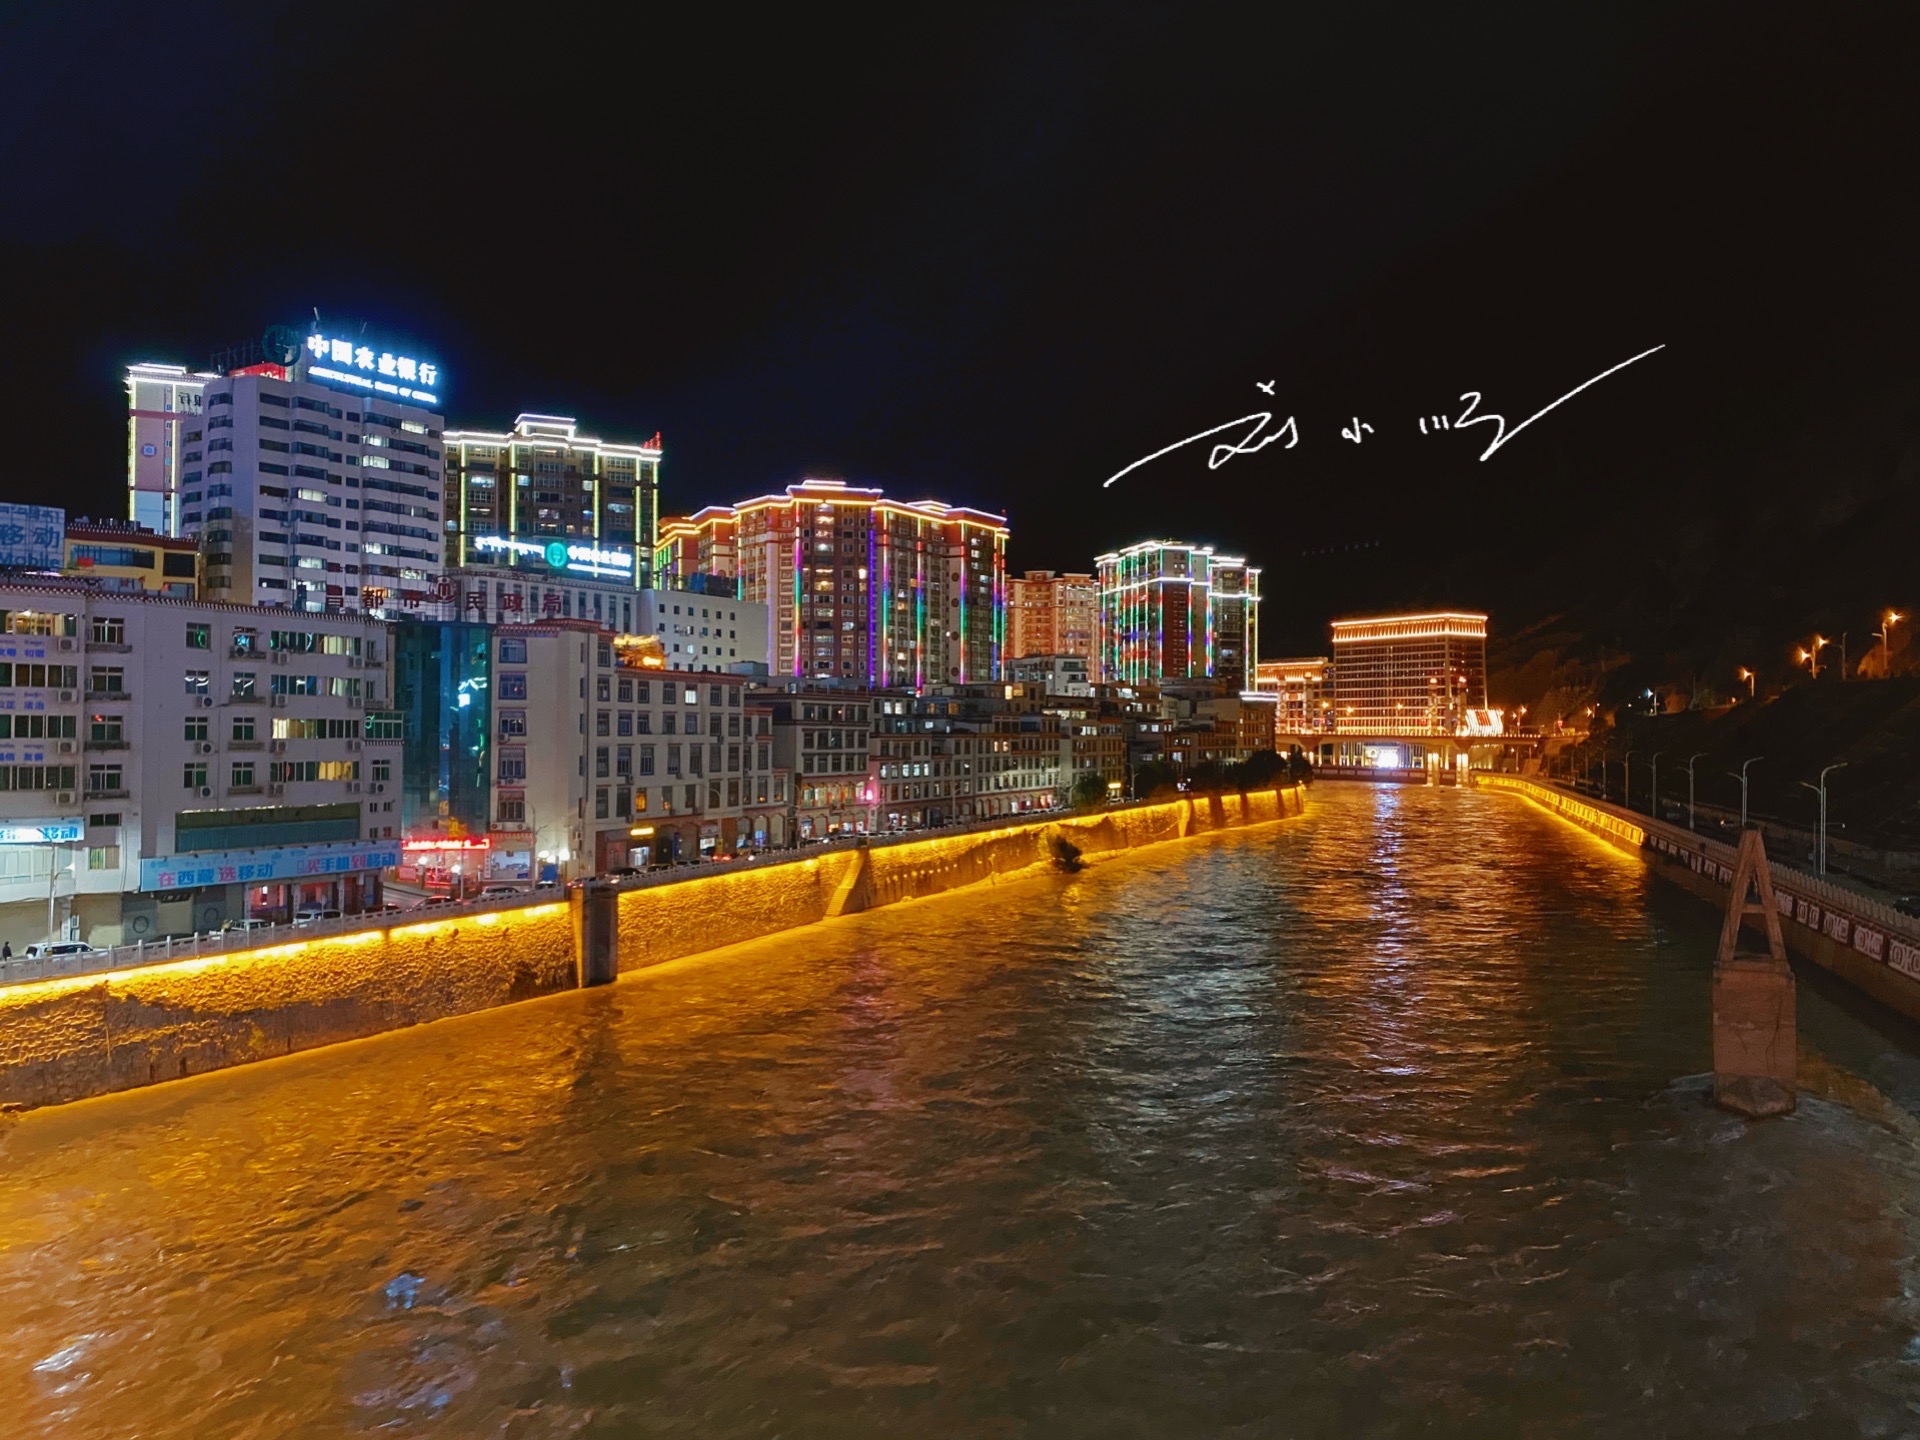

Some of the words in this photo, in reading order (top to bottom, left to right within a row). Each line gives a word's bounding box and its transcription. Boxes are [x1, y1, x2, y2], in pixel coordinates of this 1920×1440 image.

[307, 333, 437, 386] 中国农业银行
